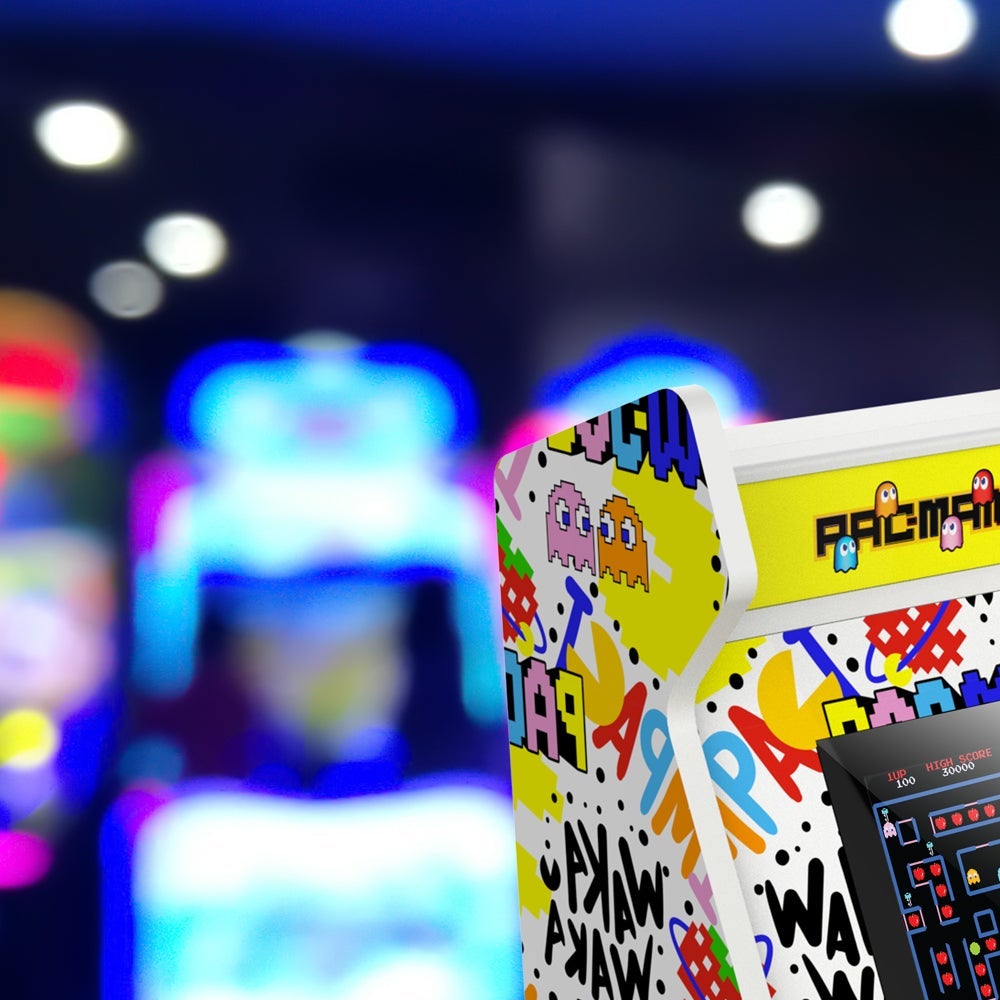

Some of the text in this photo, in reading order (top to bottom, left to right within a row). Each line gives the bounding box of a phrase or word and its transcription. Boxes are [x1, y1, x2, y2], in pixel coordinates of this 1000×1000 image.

[887, 747, 993, 782] 1UP HIGH SCORE
[896, 761, 975, 789] 100 30000
